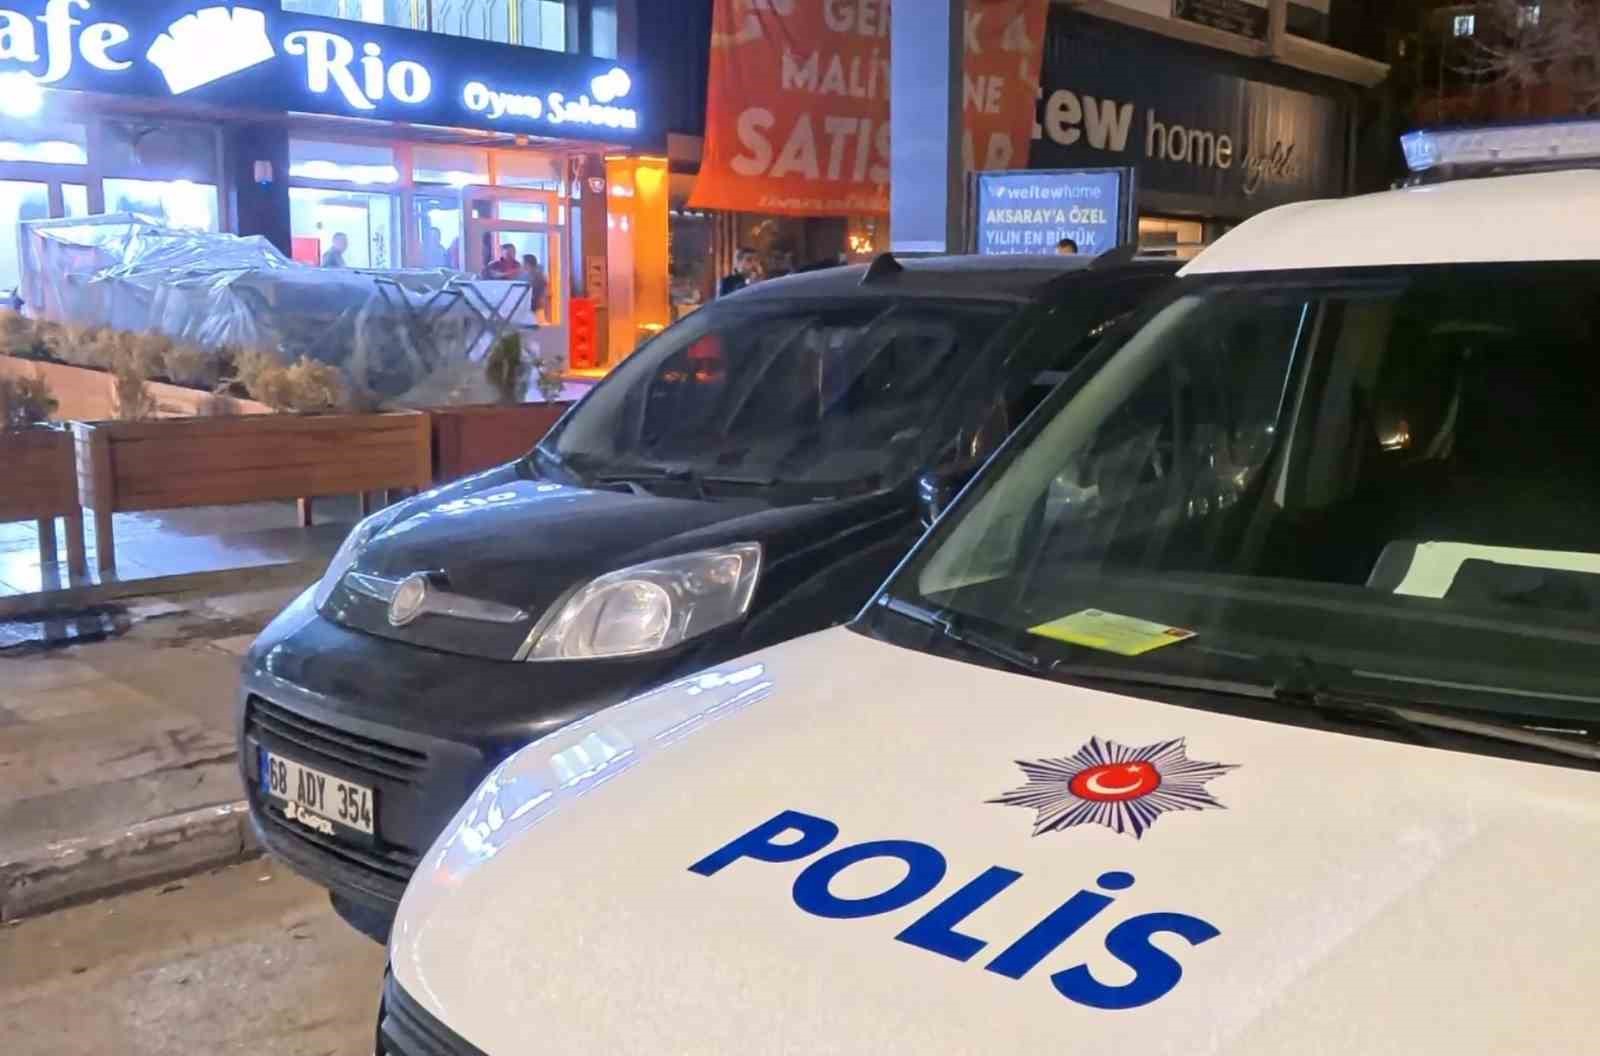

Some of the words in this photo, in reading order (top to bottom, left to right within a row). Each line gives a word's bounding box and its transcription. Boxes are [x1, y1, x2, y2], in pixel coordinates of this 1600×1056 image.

[283, 31, 431, 109] Rio
[1146, 108, 1232, 168] home
[986, 208, 1065, 224] AKSARAY'A
[1069, 204, 1107, 223] ÖZEL
[986, 230, 1021, 245] YILIN
[1024, 230, 1043, 245] EN
[270, 758, 288, 795] 68
[297, 767, 326, 811] ADY
[337, 783, 371, 829] 354
[686, 809, 1222, 1011] POLİS
